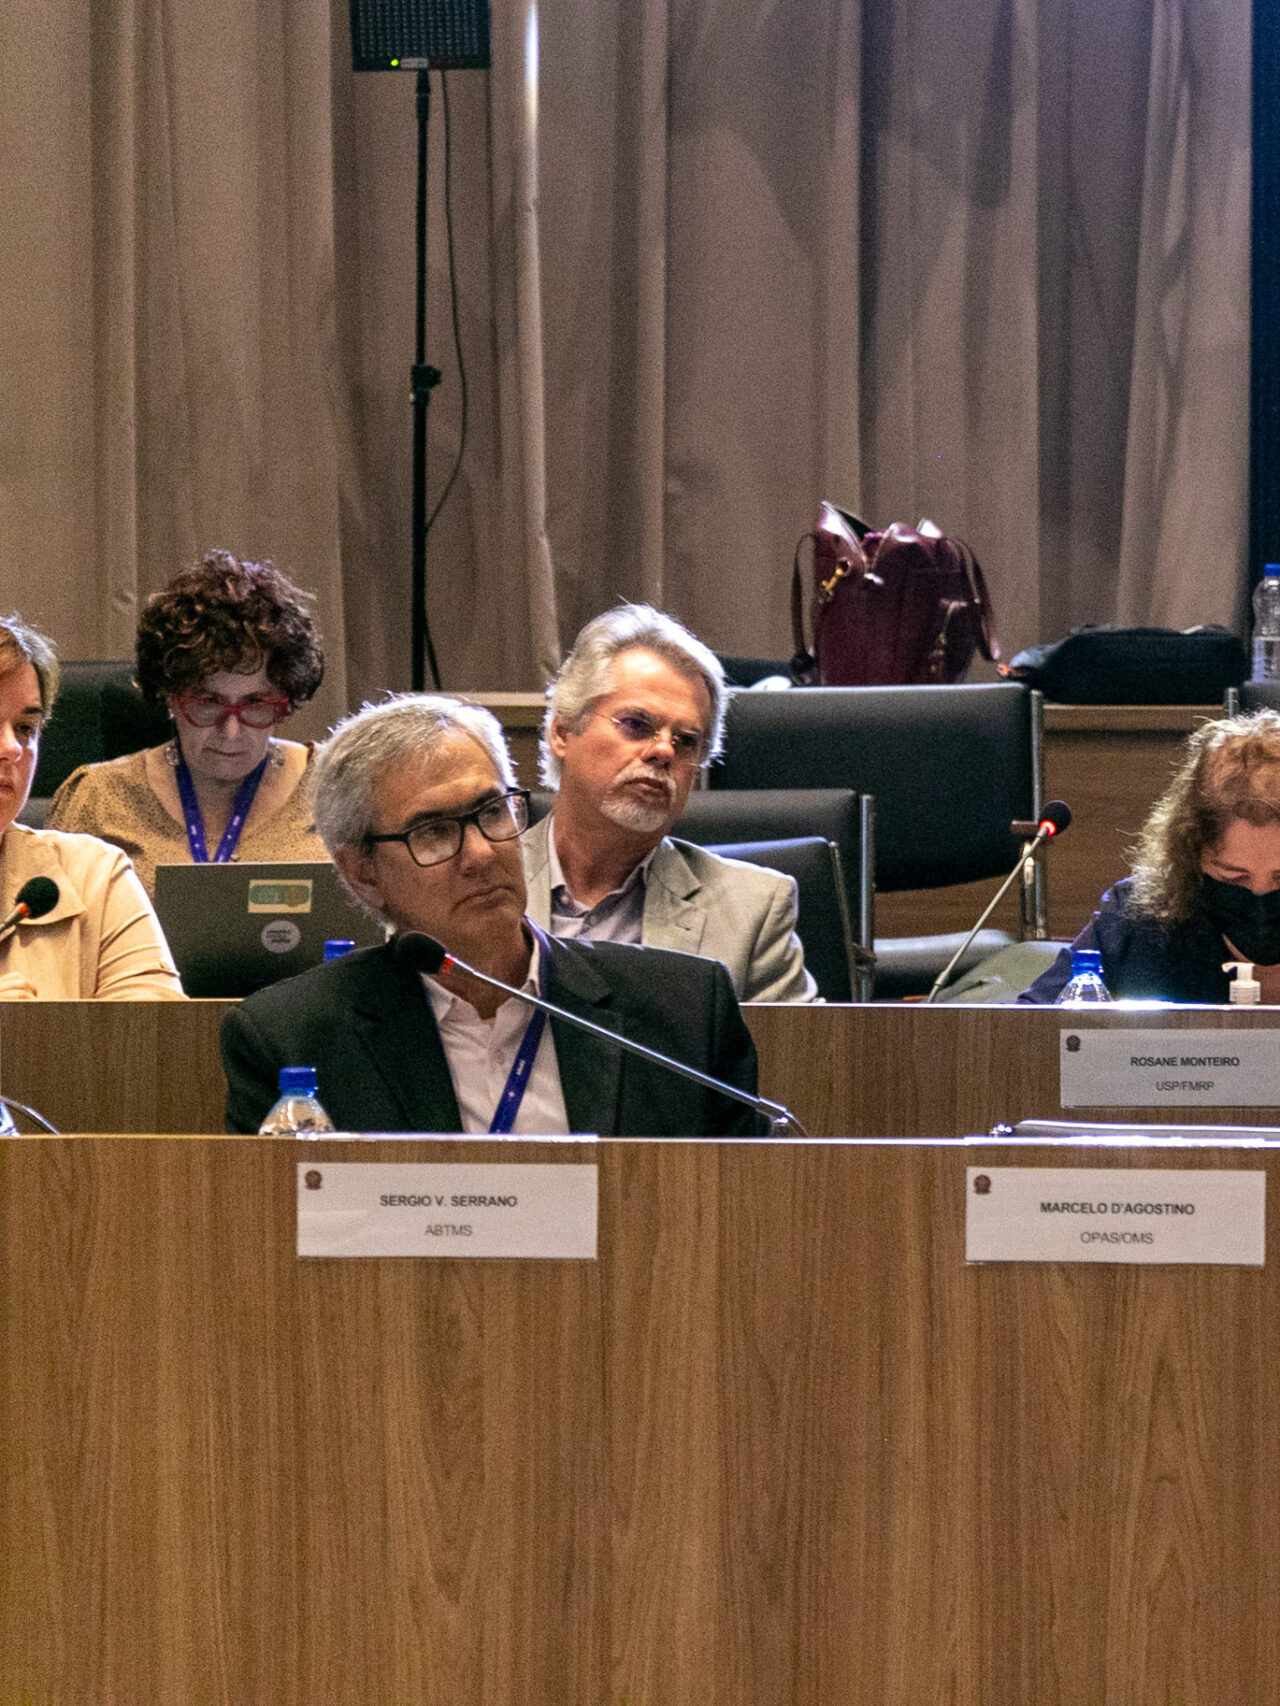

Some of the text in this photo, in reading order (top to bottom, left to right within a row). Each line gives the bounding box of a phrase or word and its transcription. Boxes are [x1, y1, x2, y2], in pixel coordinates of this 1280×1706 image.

[1130, 1056, 1240, 1067] ROSANE MONTEIRO
[379, 1195, 518, 1208] SERGIO V. SERRANO
[1040, 1202, 1195, 1215] MARCELO D'AGOSTINO
[424, 1225, 473, 1237] ABTMS
[1080, 1232, 1154, 1244] OPAS/OMS
